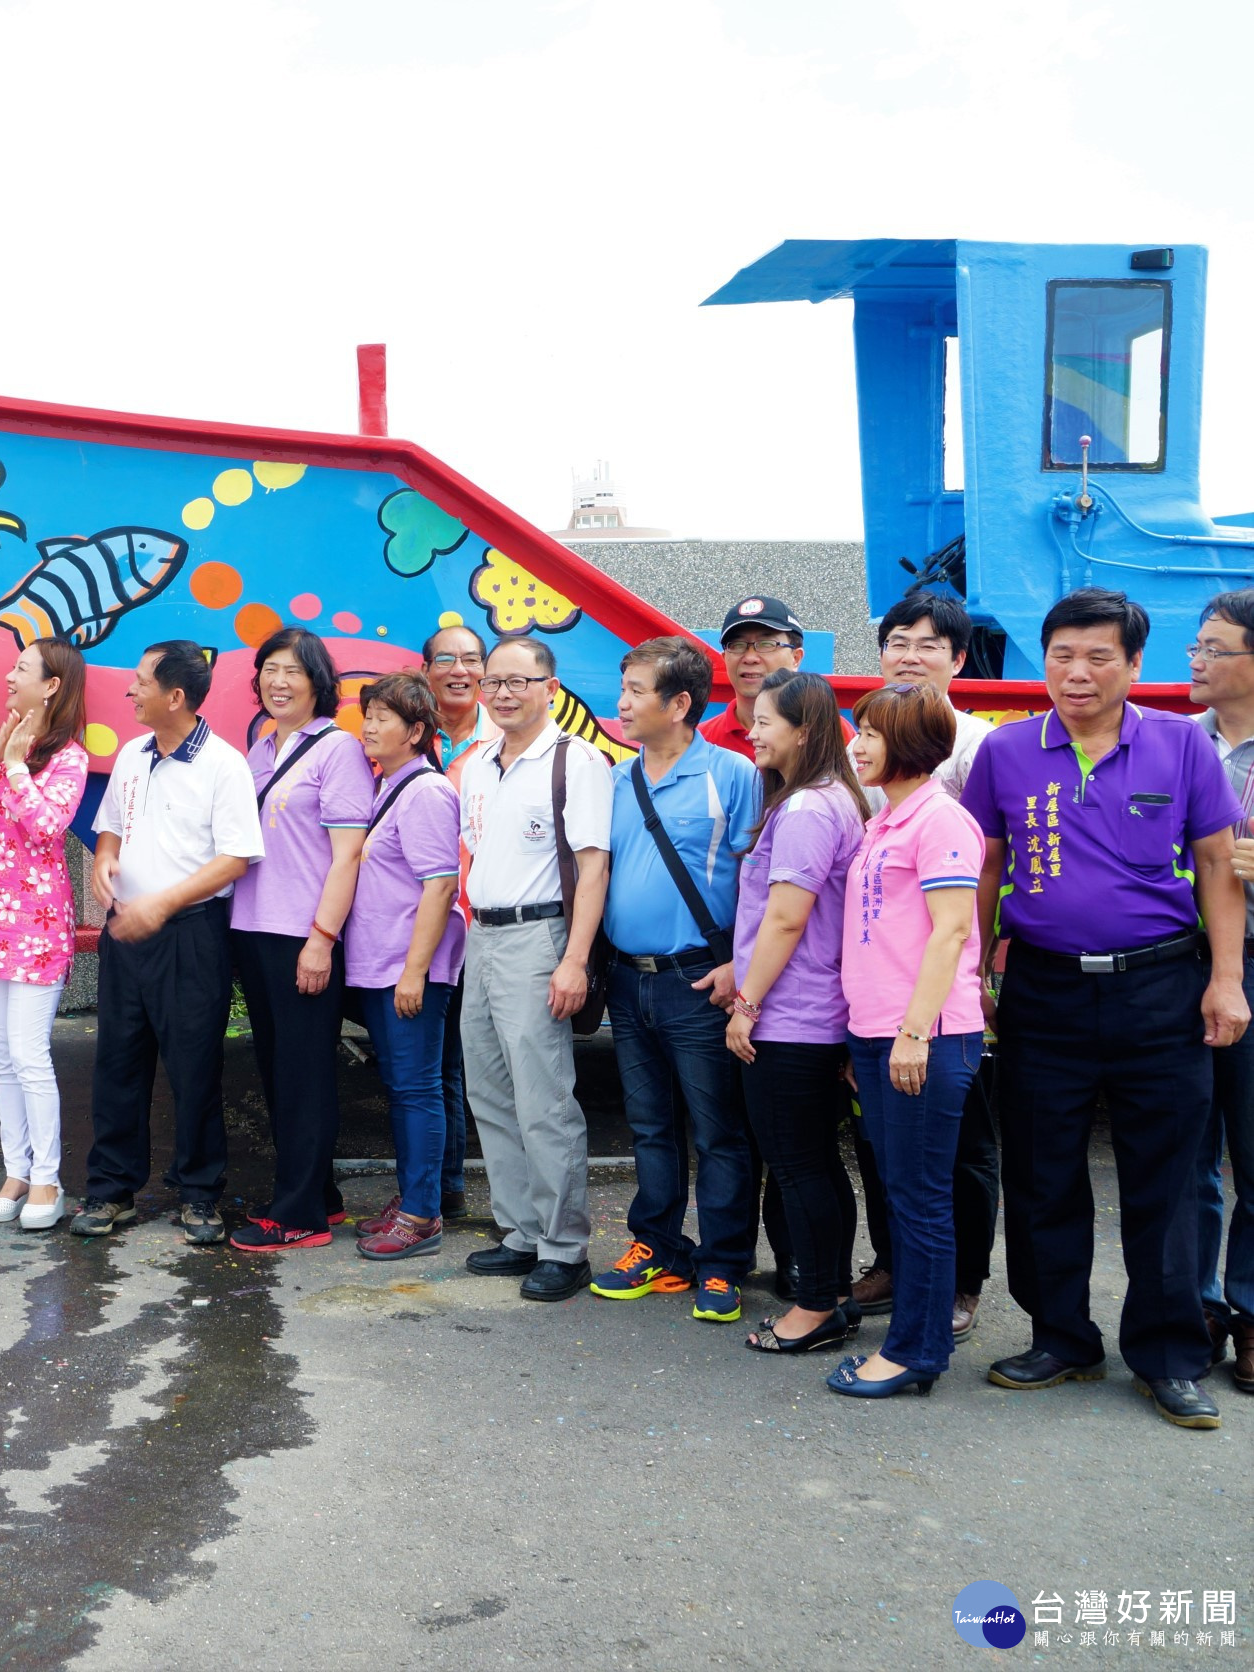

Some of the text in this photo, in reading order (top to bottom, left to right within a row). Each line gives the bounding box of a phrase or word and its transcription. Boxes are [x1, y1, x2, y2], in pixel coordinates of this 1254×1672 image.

[1045, 781, 1062, 877] 新屋區新屋里
